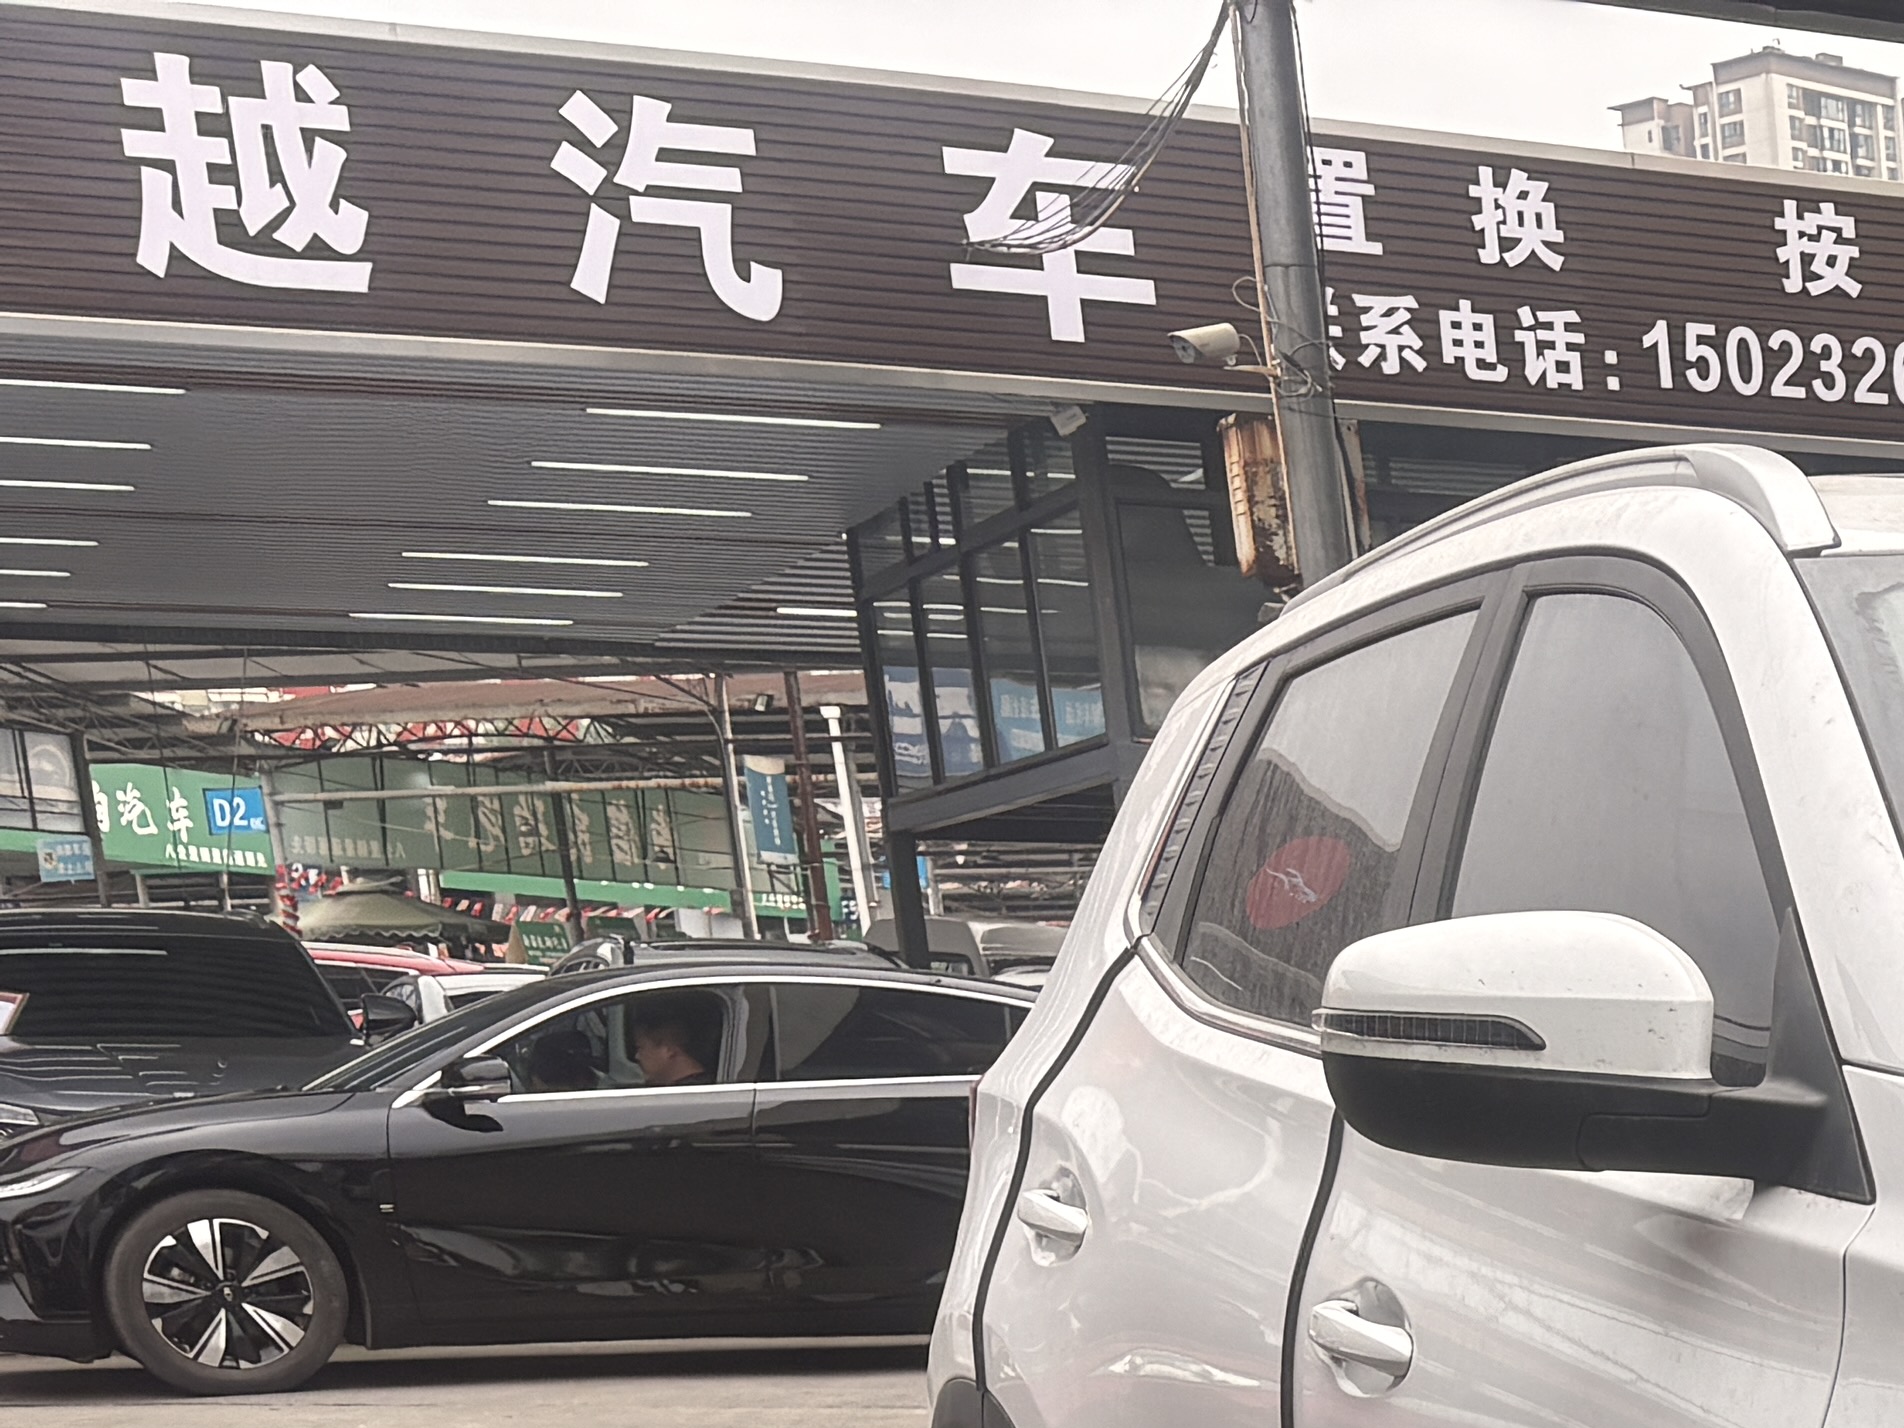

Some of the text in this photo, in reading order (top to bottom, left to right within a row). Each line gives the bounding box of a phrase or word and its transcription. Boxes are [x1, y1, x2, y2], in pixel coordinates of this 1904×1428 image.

[119, 51, 1157, 343] 越汽车
[1306, 145, 1566, 273] 置换
